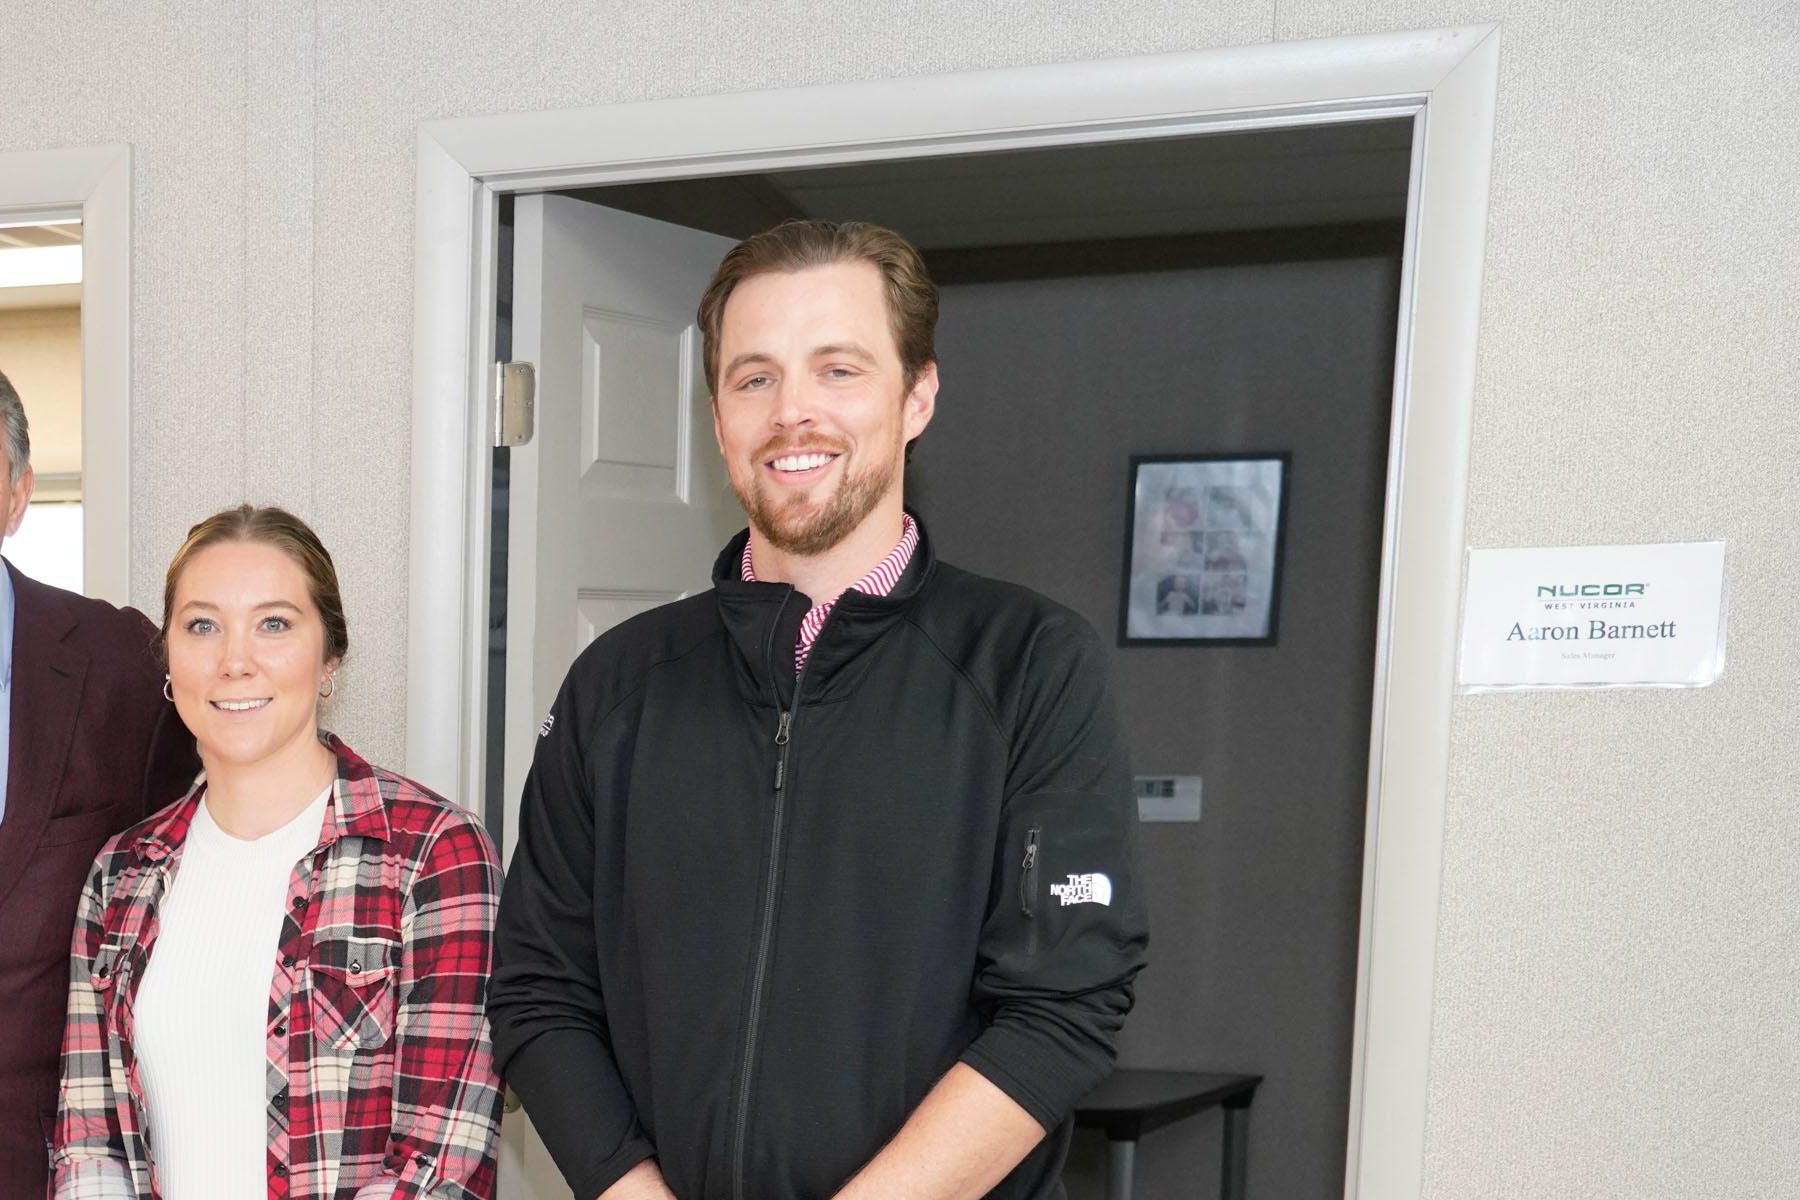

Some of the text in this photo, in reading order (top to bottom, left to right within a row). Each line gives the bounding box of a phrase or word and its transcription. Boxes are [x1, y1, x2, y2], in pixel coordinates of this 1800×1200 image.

[1537, 583, 1645, 597] NUCOR
[1544, 601, 1636, 610] WEST VIRGINIA
[1506, 619, 1677, 641] Aaron Barnett
[1067, 873, 1092, 885] THE
[1050, 884, 1092, 896] NORTH
[1060, 894, 1092, 906] FACE
